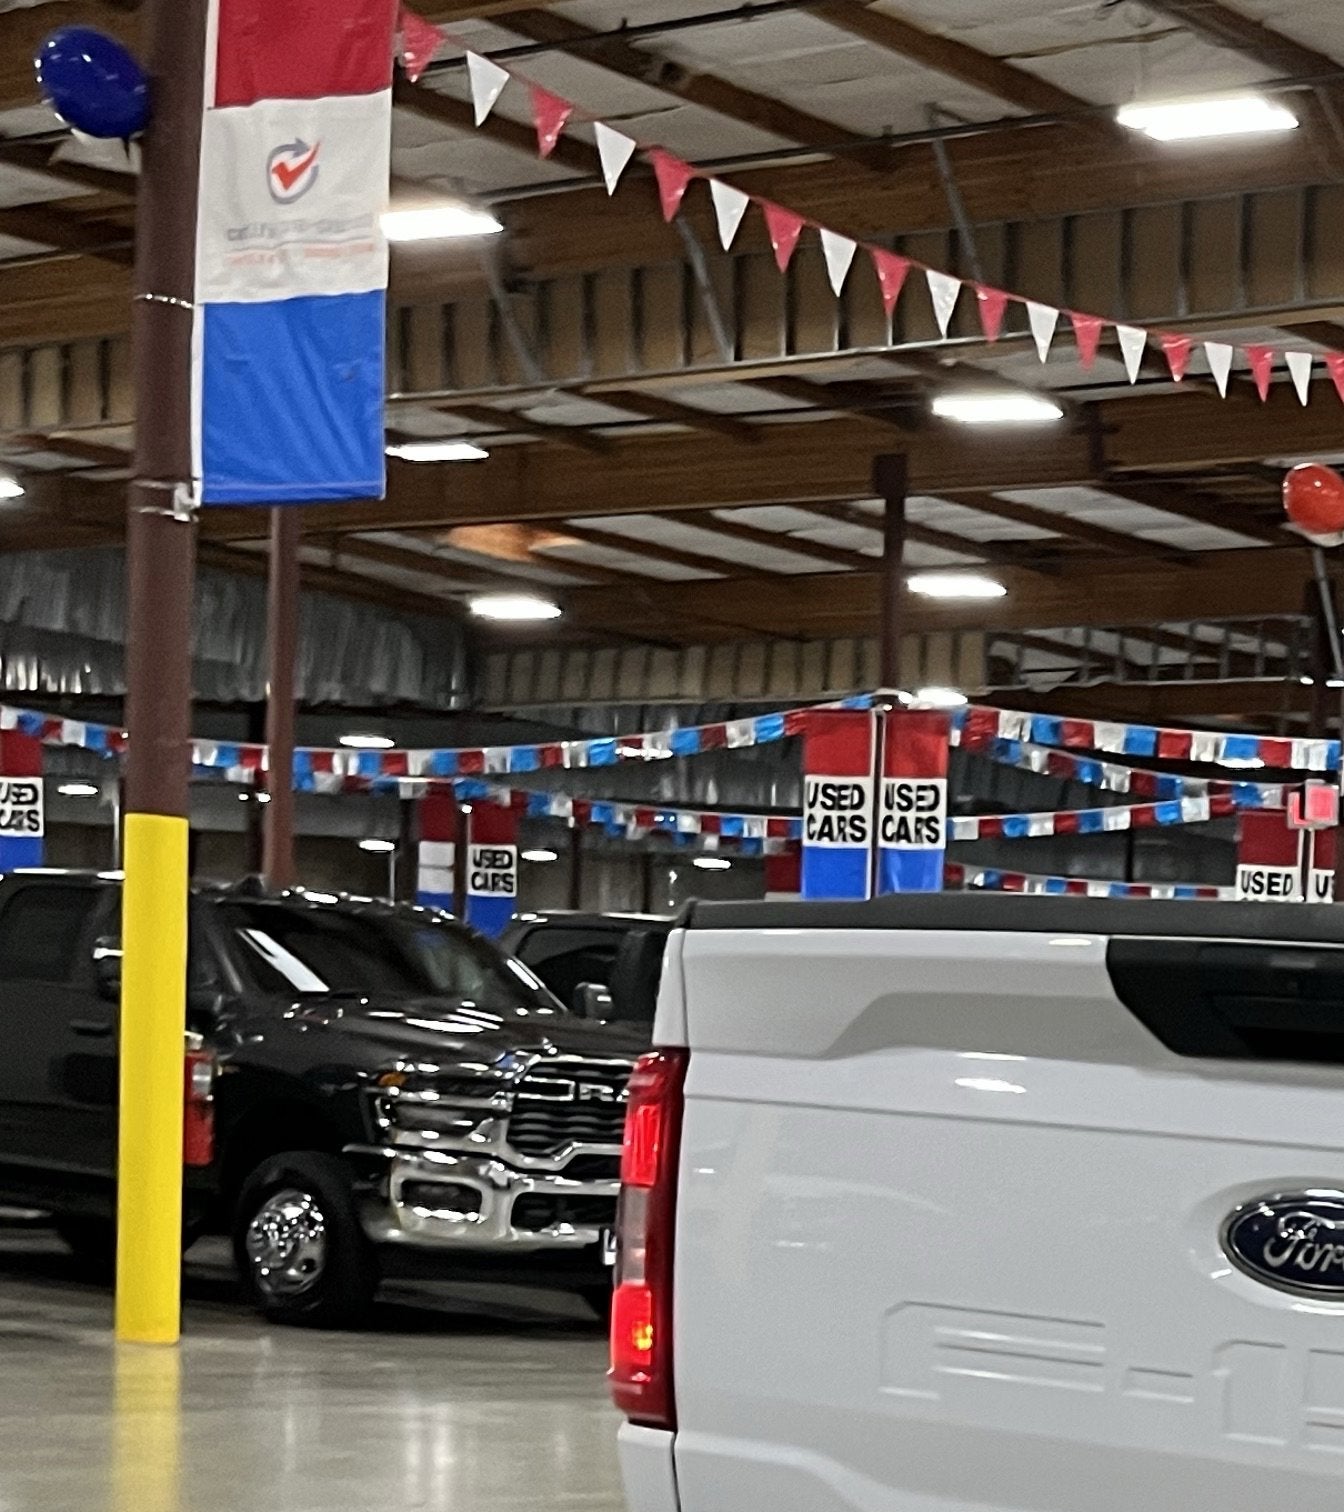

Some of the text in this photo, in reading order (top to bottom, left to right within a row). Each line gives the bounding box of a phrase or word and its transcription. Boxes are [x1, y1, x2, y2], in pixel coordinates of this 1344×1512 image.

[804, 782, 865, 811] USED
[884, 783, 941, 812] USED
[806, 813, 867, 843] CARS
[881, 814, 941, 844] CARS
[1241, 870, 1293, 896] USED
